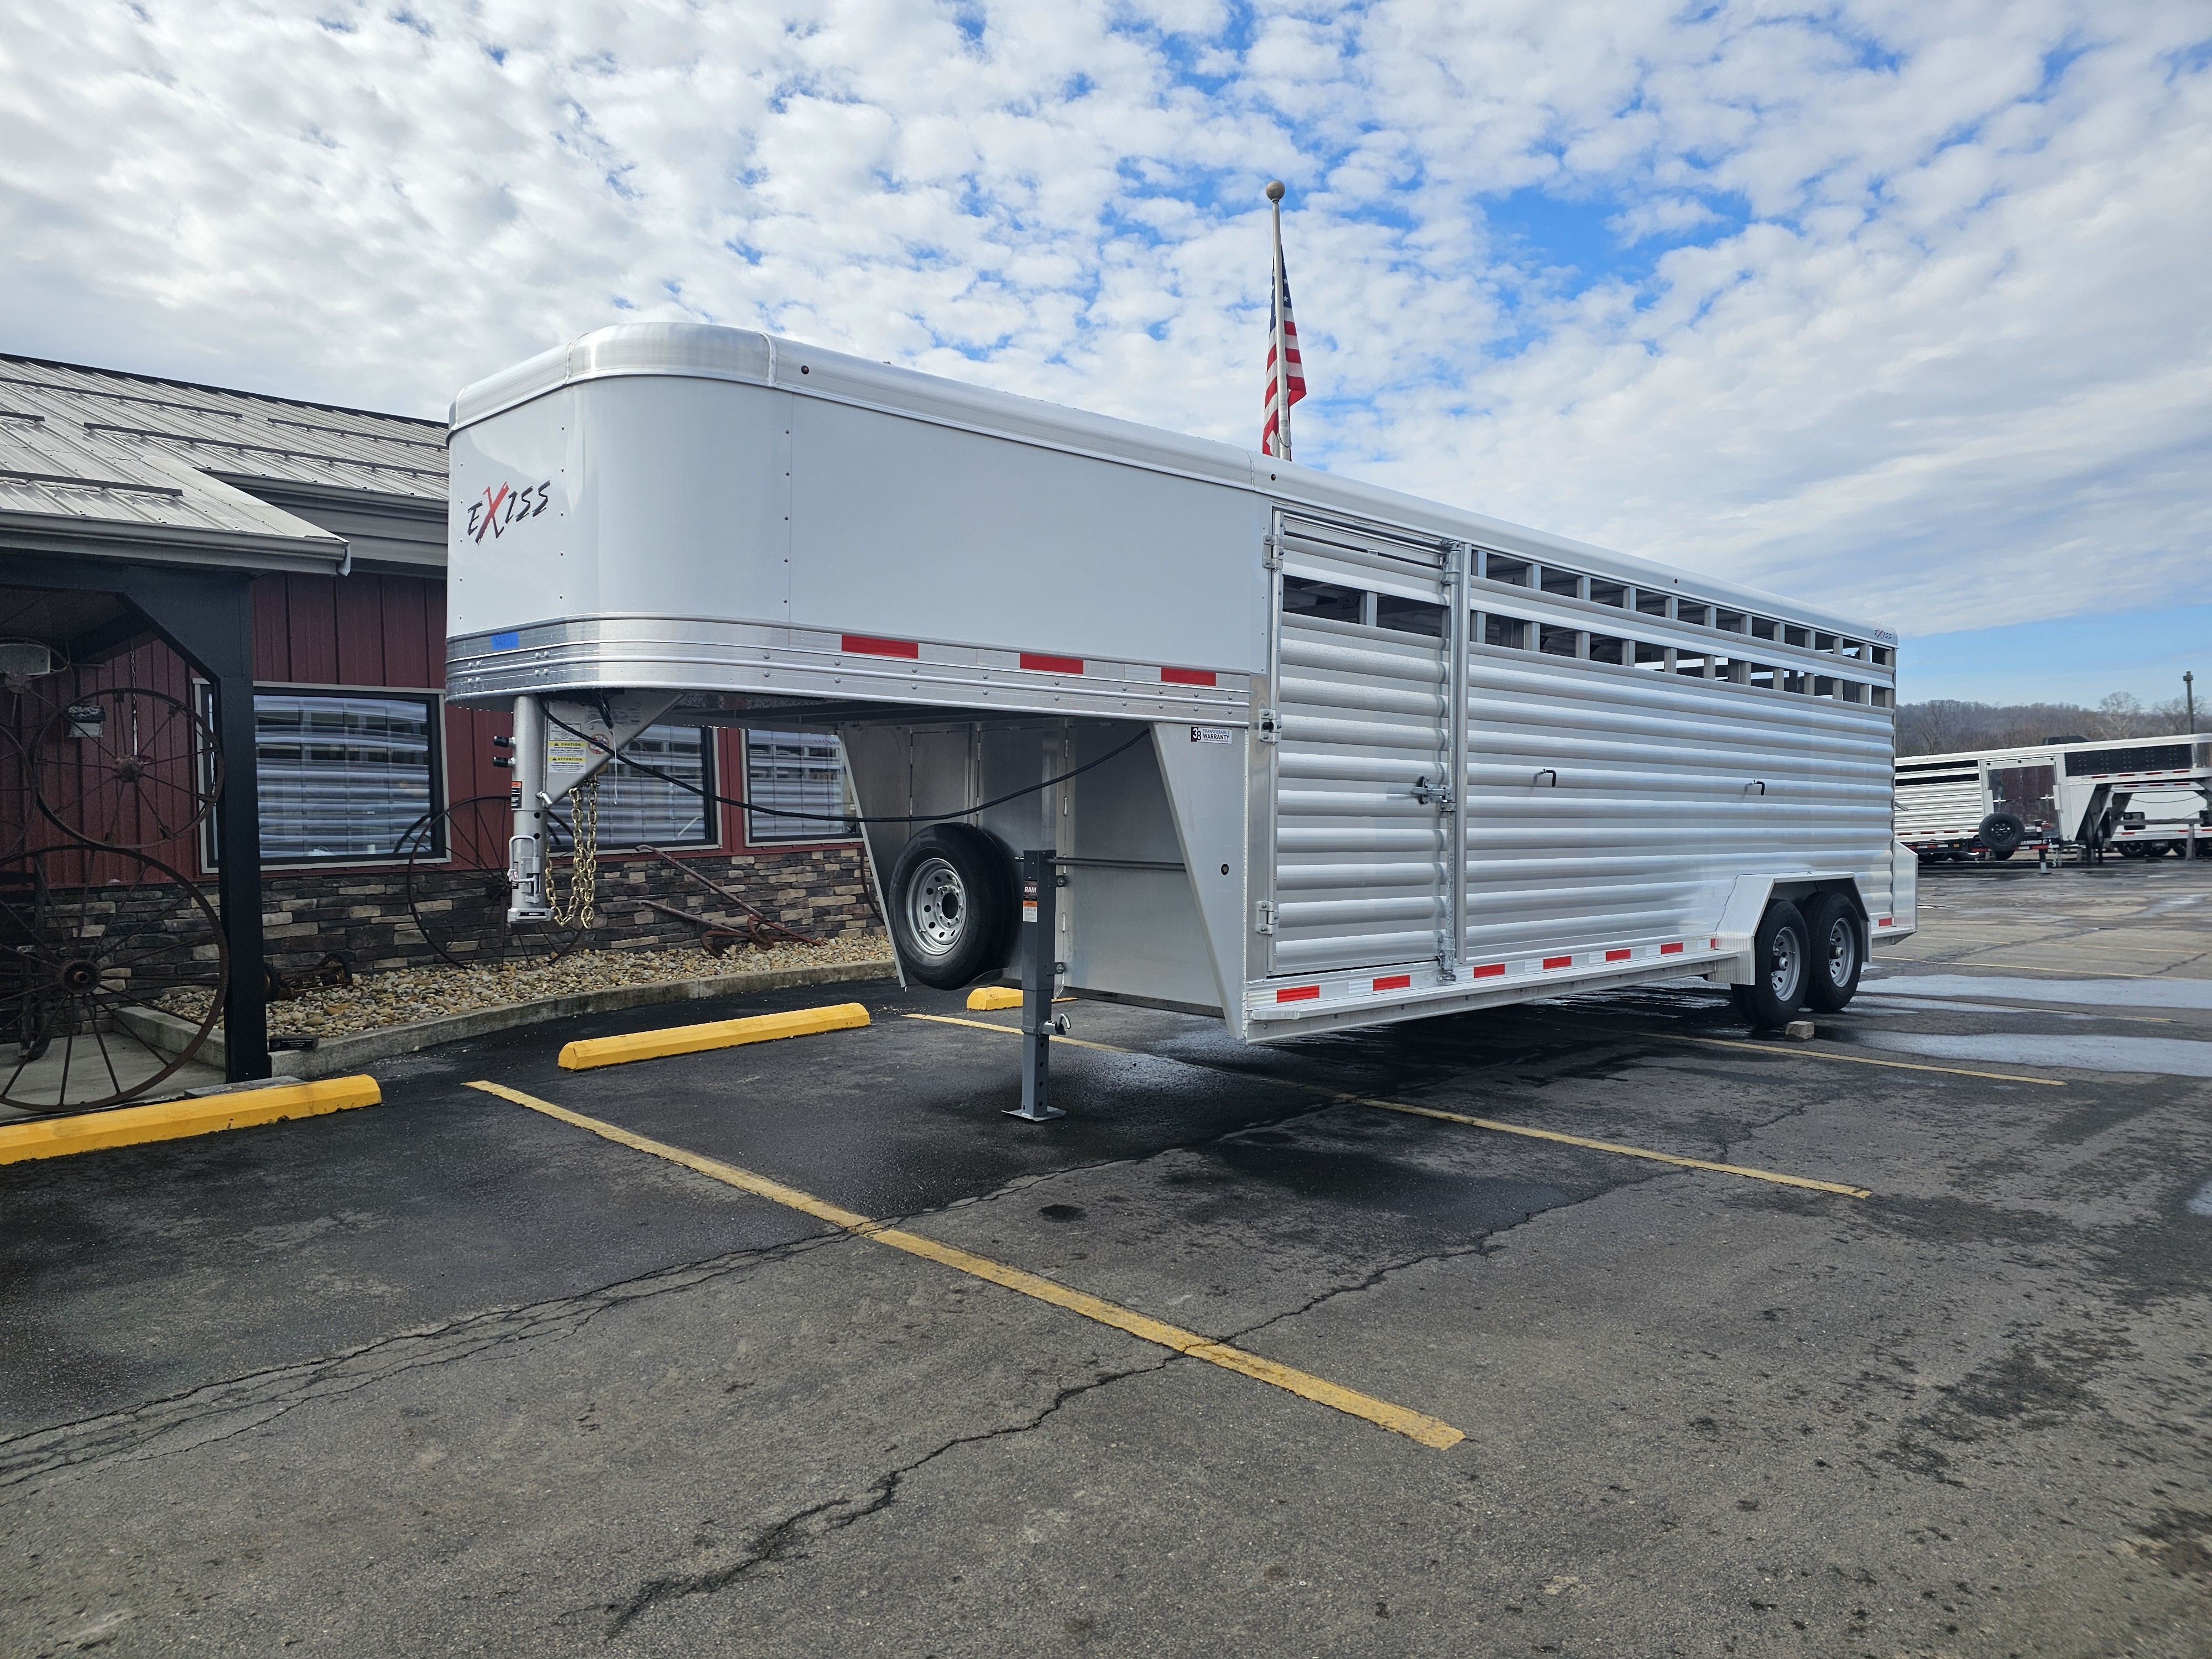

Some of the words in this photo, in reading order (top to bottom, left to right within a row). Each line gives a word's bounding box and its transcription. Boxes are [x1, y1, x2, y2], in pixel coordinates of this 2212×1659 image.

[467, 480, 551, 546] EXISS
[1874, 628, 1892, 639] EXISS
[1193, 728, 1202, 741] 38
